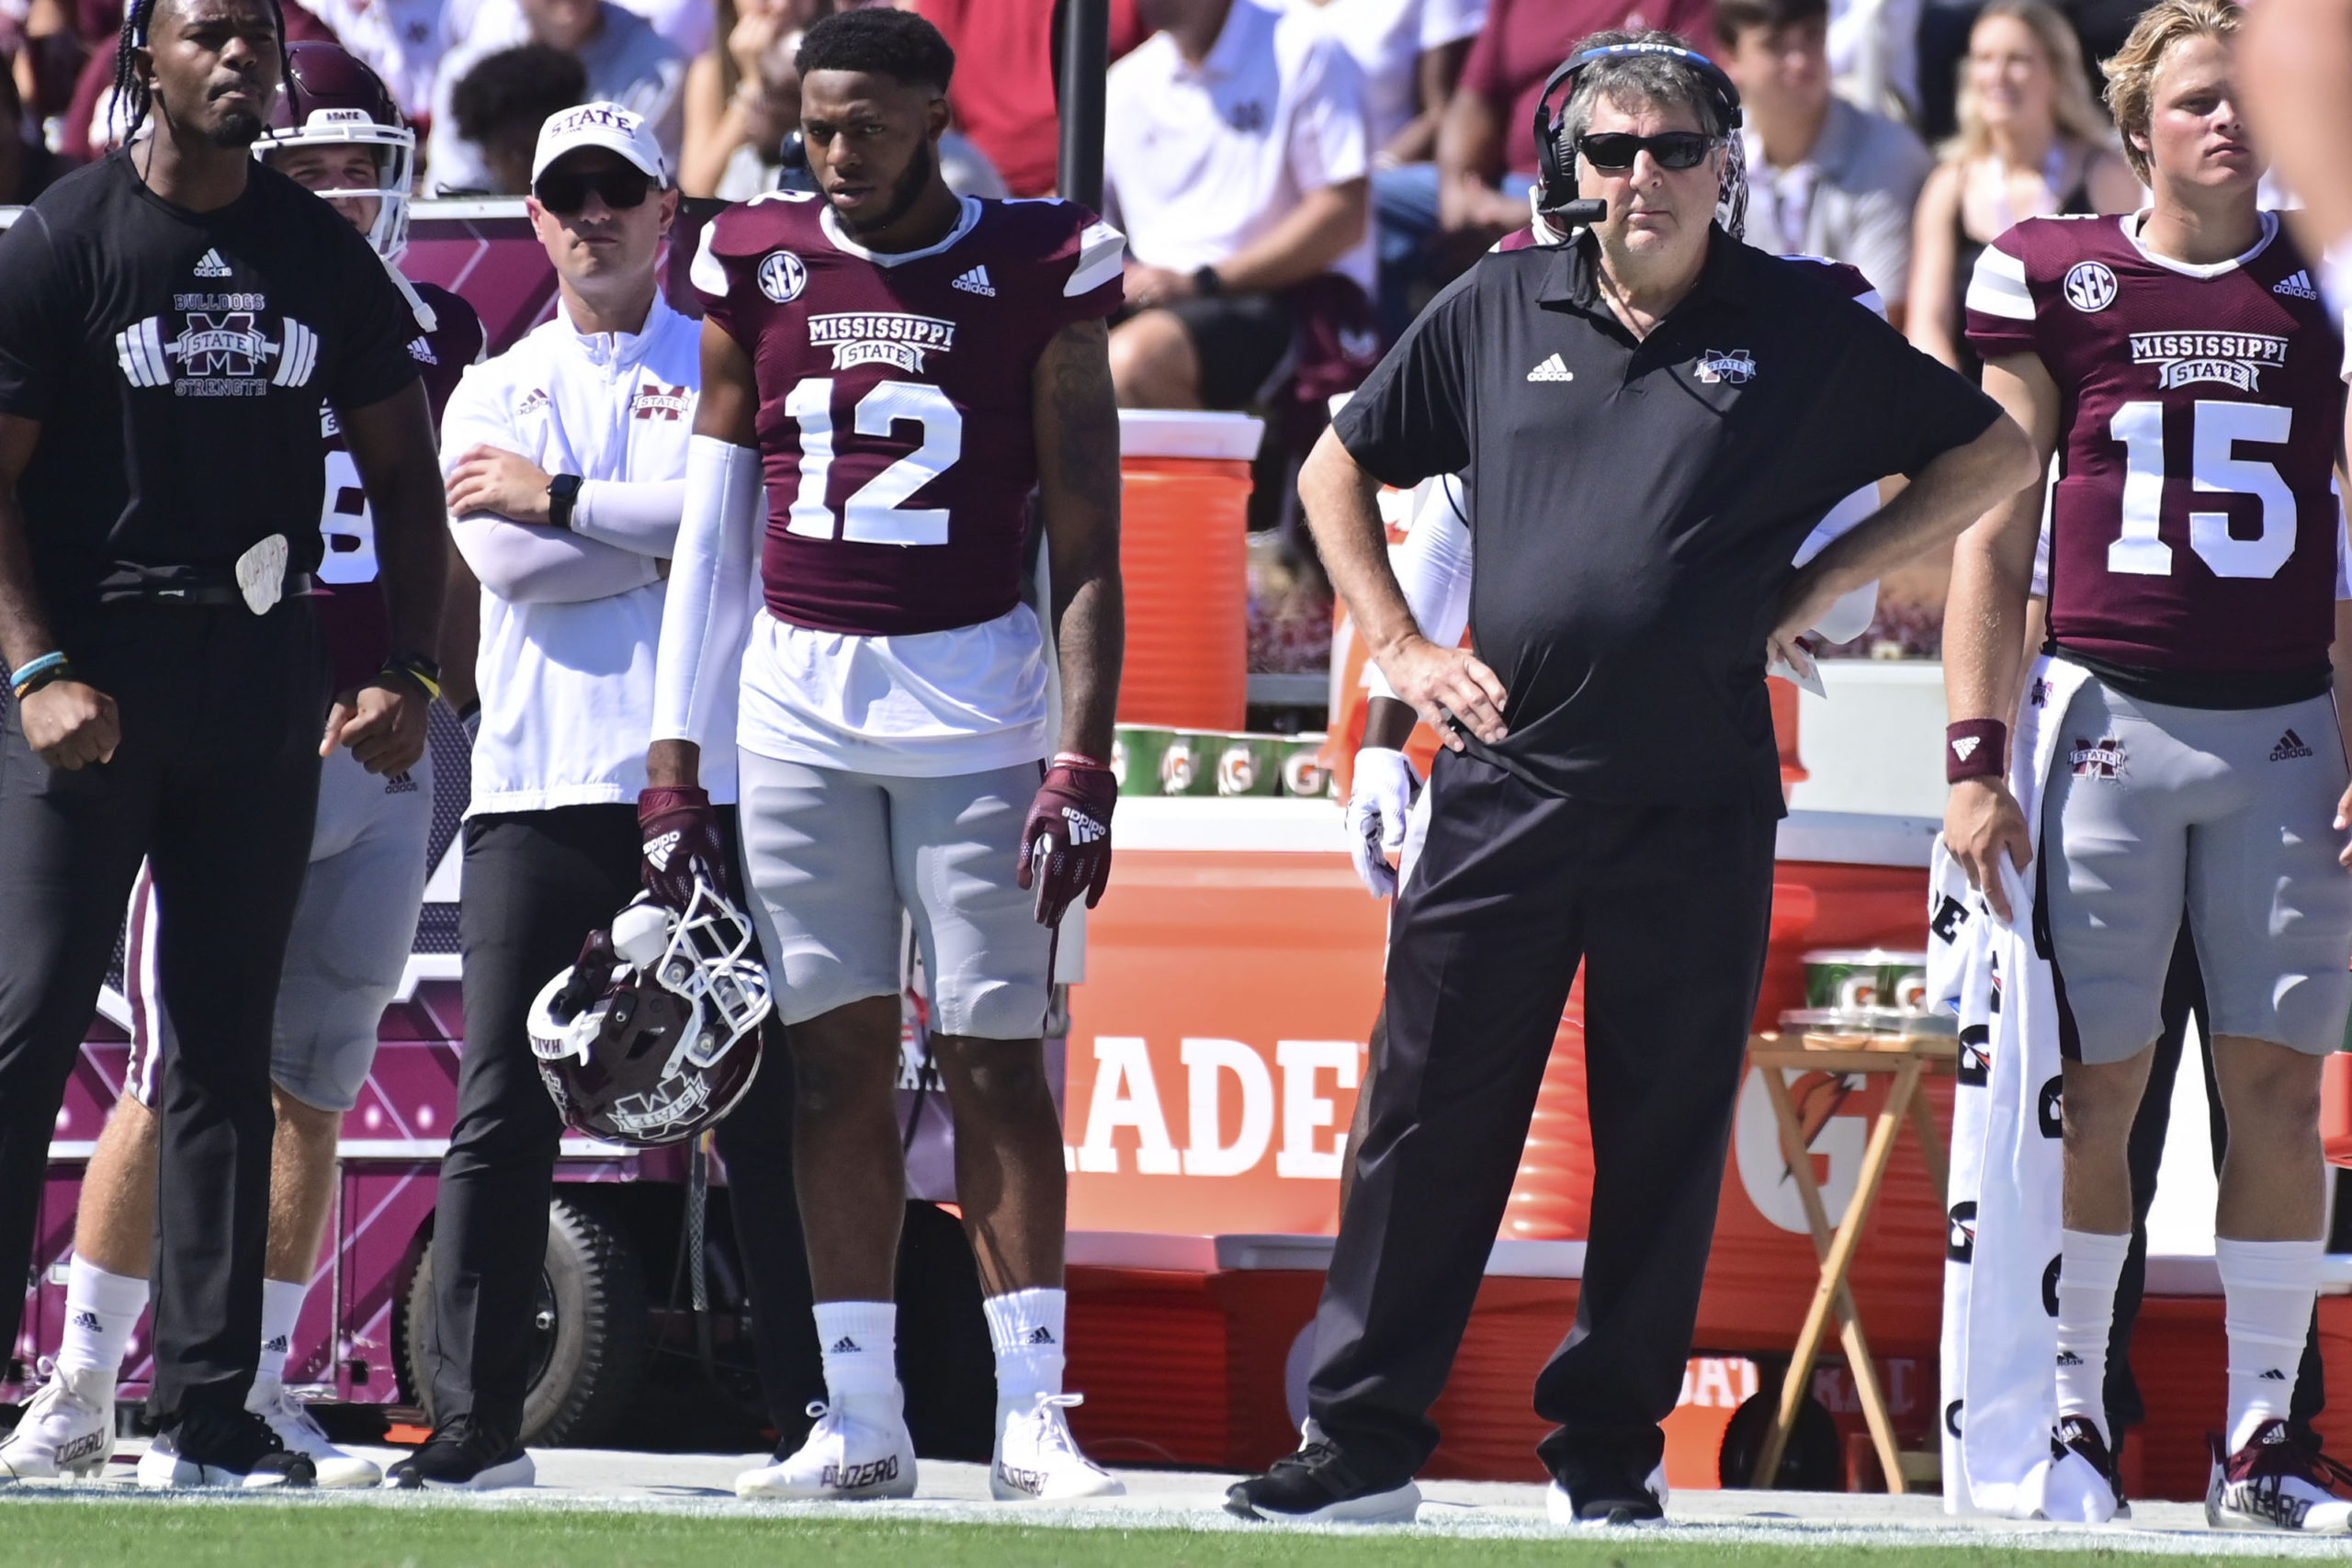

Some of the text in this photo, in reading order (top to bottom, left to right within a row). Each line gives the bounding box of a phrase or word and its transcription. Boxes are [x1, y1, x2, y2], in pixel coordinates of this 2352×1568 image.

[551, 108, 636, 140] STATE
[194, 265, 232, 277] adidas
[764, 256, 801, 300] SEC
[952, 278, 995, 297] adidas
[2069, 263, 2112, 311] SEC
[2273, 283, 2316, 300] adidas
[174, 293, 265, 310] BULLDOGS
[808, 319, 956, 345] MISSISSIPPI
[192, 333, 247, 352] STATE
[2130, 335, 2289, 363] MISSISSIPPI
[848, 344, 908, 364] STATE
[1707, 358, 1747, 372] STATE
[2177, 361, 2243, 386] STATE
[1527, 371, 1574, 382] adidas
[175, 378, 266, 396] STRENGTH
[640, 396, 681, 409] STATE
[784, 378, 962, 546] 12
[2108, 400, 2297, 579] 15
[2076, 750, 2116, 764] STATE
[2269, 746, 2313, 762] adidas
[385, 781, 419, 795] adidas
[1062, 807, 1106, 836] adidas
[643, 830, 681, 854] adidas
[532, 1034, 562, 1055] HAIL
[1064, 1035, 1358, 1179] ADE
[1735, 1066, 1868, 1235] G
